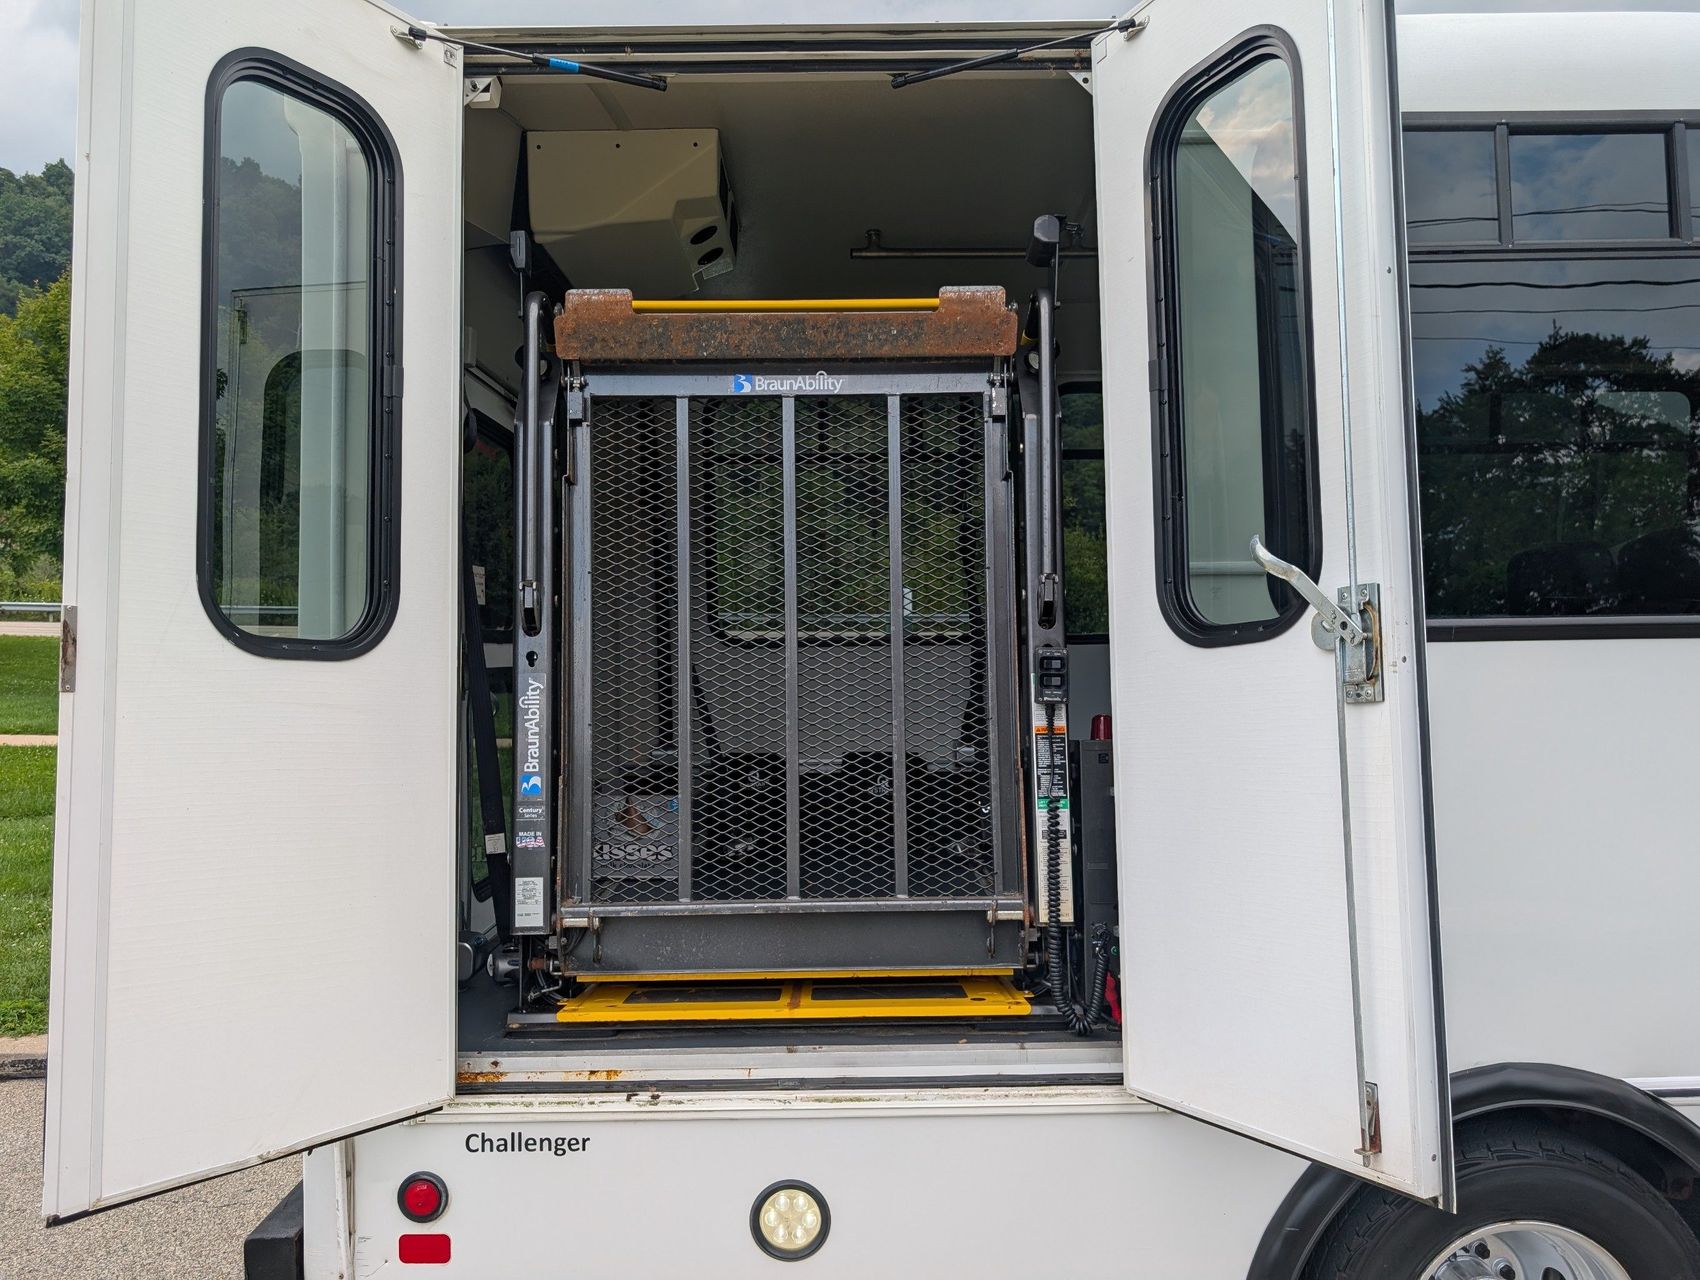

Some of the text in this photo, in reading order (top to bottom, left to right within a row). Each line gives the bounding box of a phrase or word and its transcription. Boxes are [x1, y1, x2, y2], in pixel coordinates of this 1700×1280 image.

[755, 371, 843, 393] BraunAbility
[518, 677, 544, 772] BraunAbility
[515, 836, 546, 848] USA
[464, 1132, 591, 1156] Challenger
